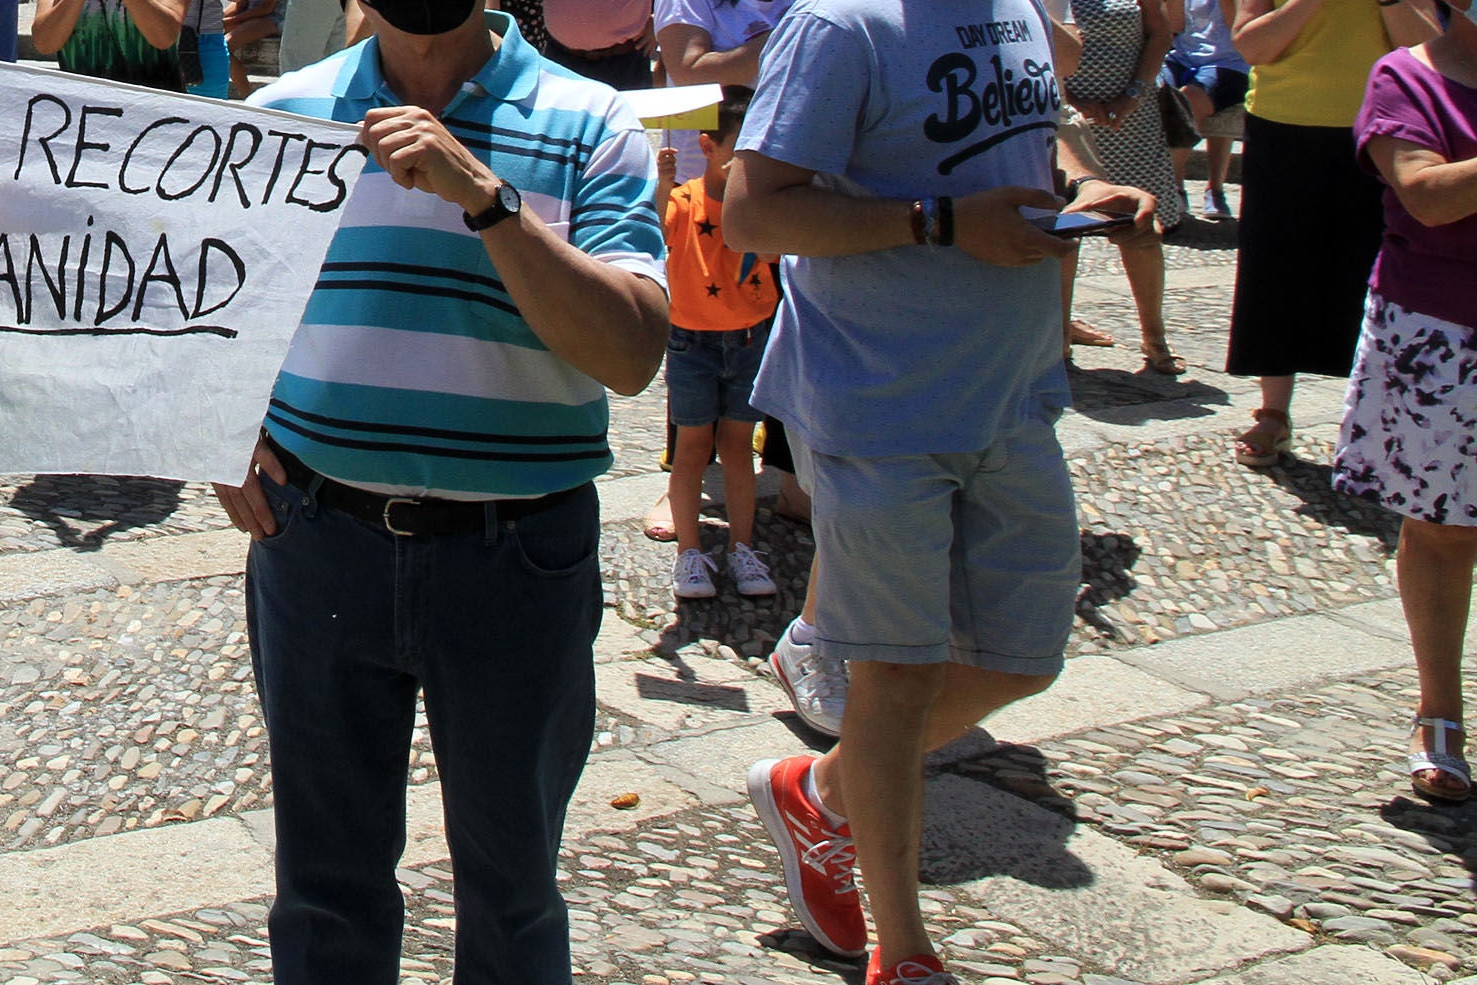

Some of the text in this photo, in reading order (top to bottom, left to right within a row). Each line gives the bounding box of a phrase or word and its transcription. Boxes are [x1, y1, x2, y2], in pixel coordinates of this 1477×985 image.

[955, 20, 1033, 49] DAY DREAM
[923, 52, 1061, 143] Believe
[14, 93, 369, 212] RECORTES
